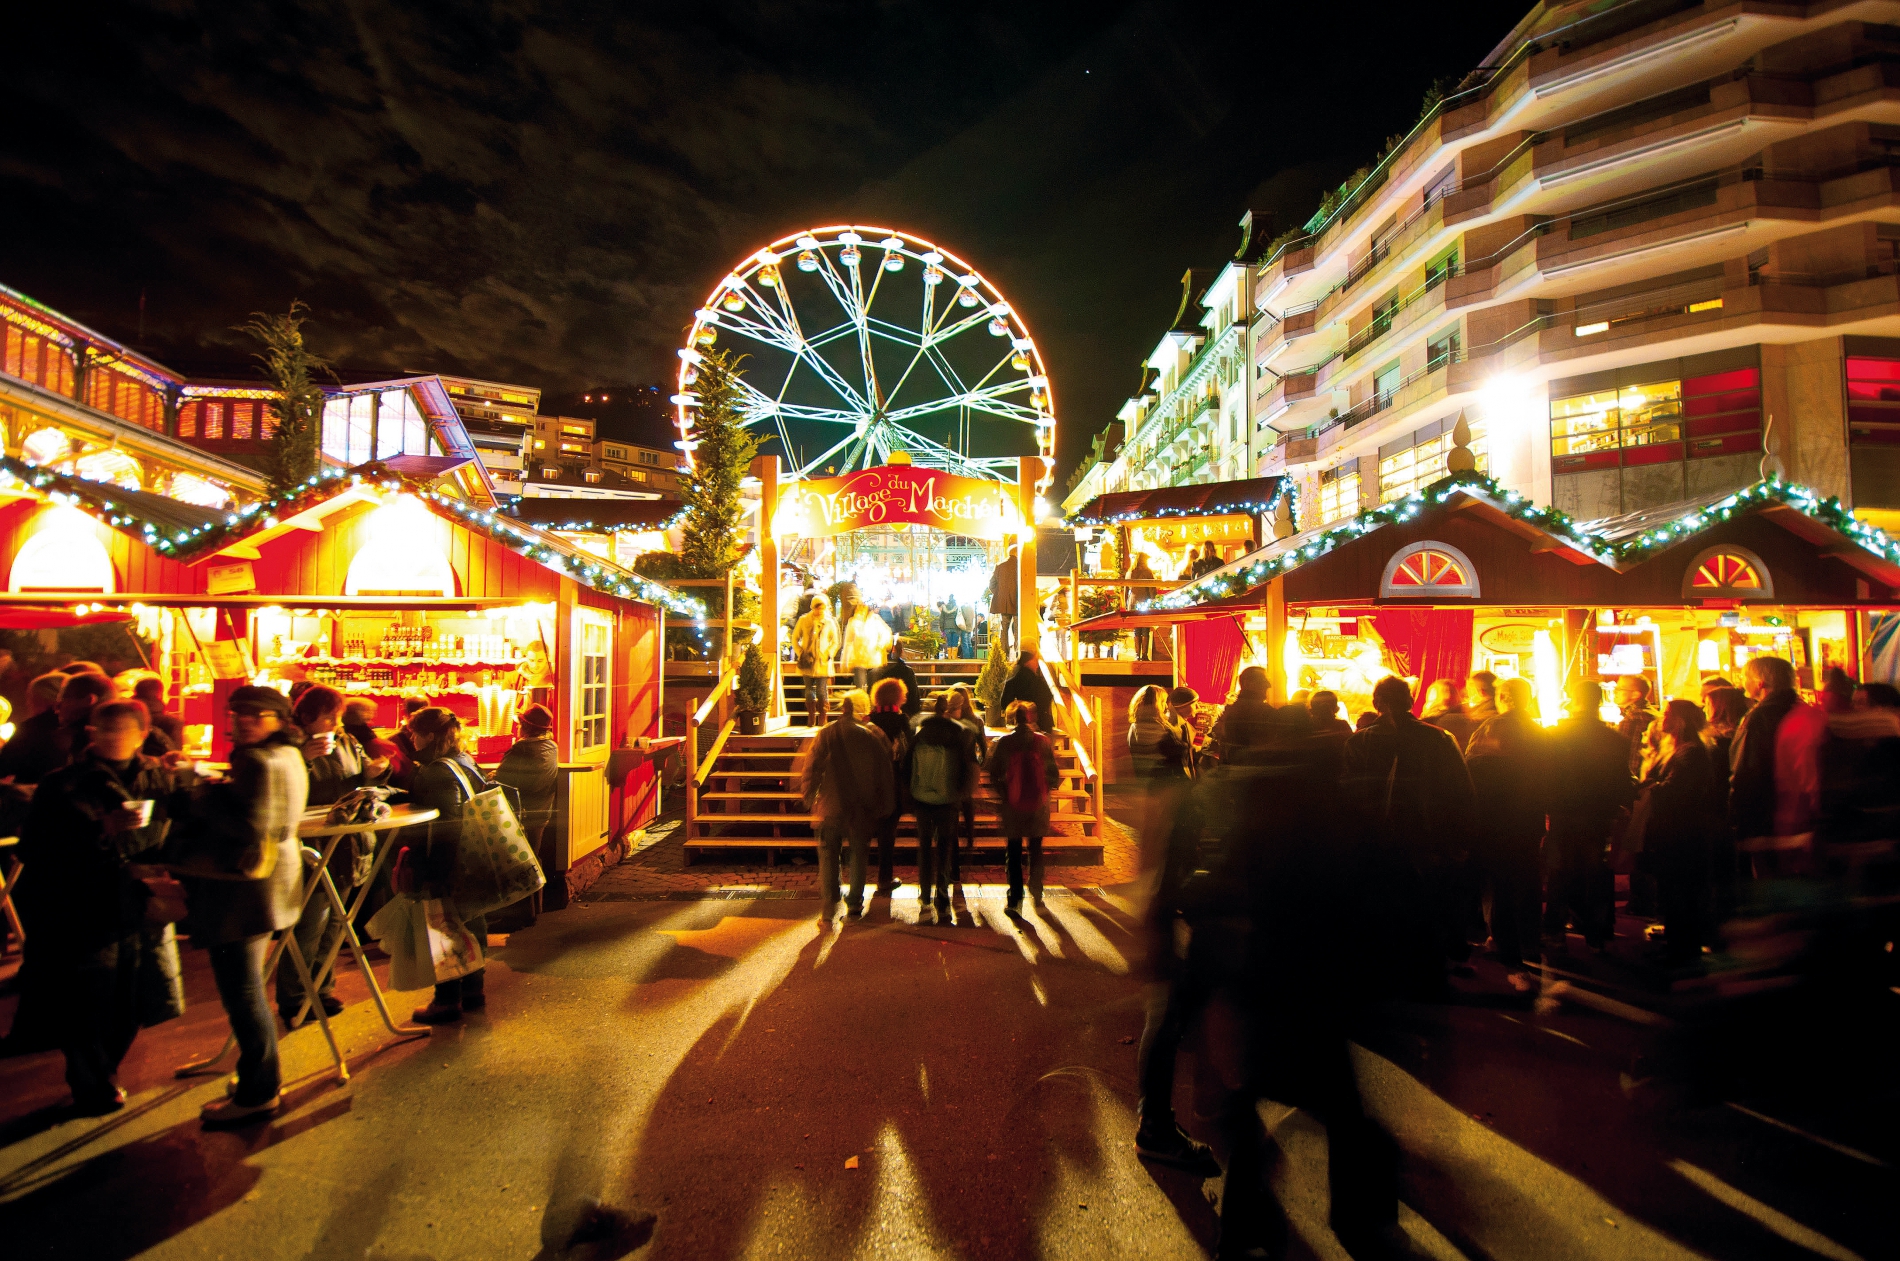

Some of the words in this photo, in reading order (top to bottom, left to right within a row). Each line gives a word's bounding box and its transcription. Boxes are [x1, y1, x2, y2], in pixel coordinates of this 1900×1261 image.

[804, 472, 905, 527] Village
[888, 474, 909, 489] du
[903, 477, 993, 521] Marché
